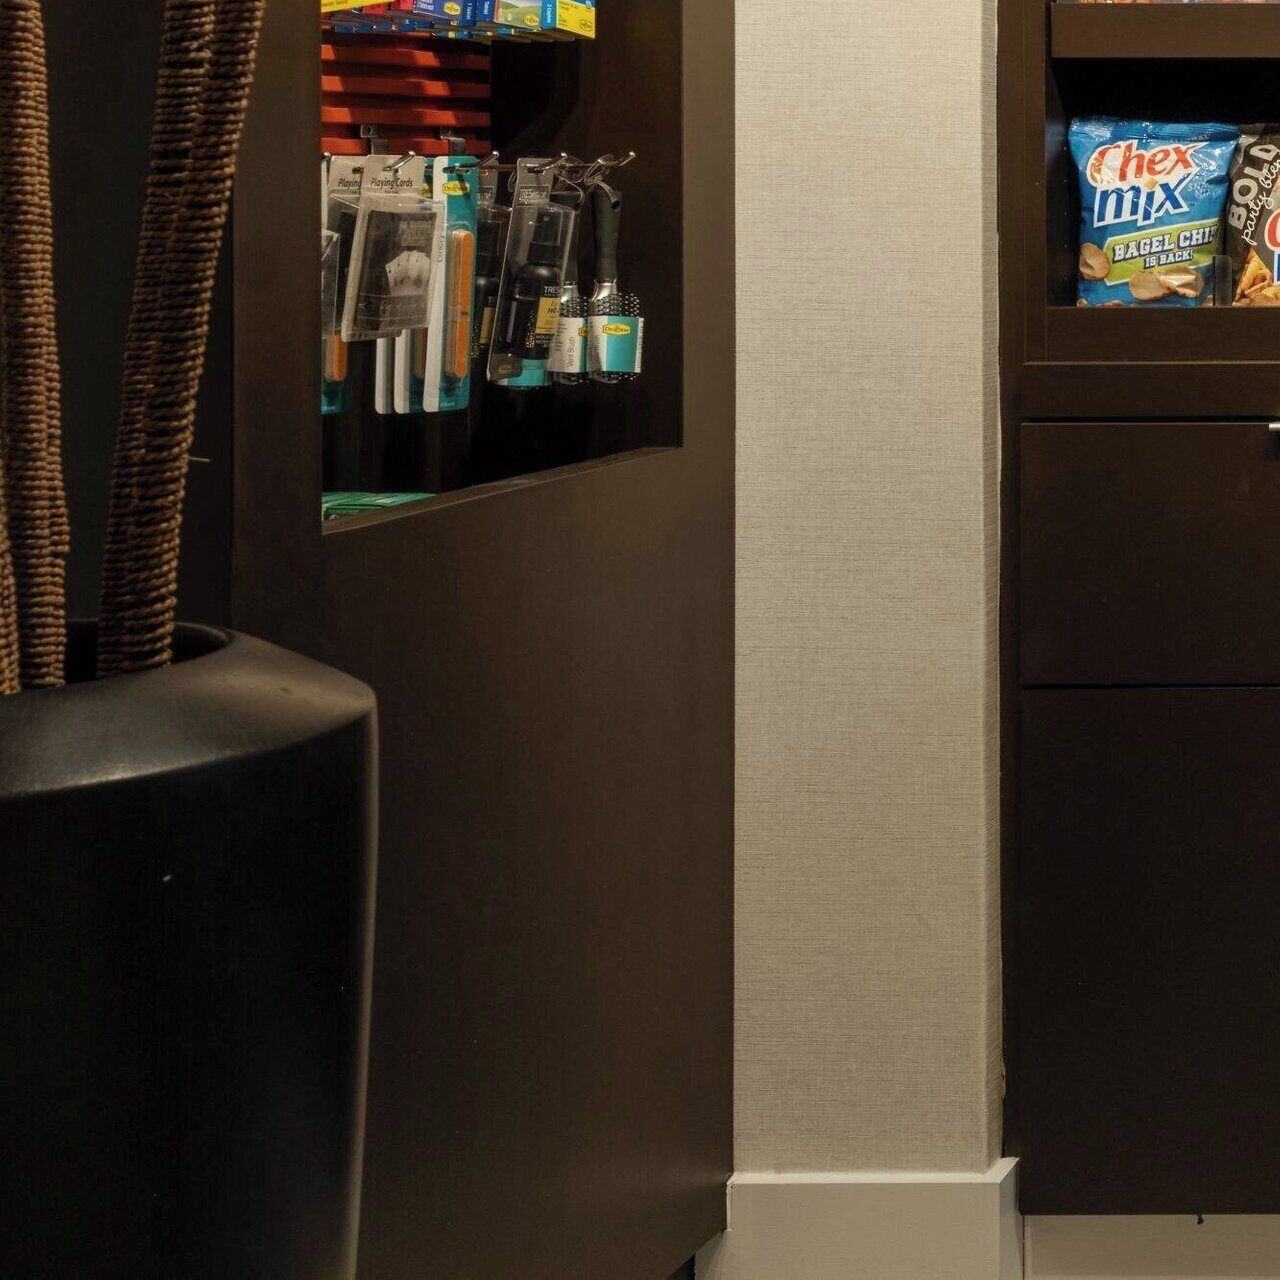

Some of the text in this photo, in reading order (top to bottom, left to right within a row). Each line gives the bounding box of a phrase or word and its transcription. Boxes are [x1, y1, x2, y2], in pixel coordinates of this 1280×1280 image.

[371, 177, 395, 190] Playing
[1088, 141, 1209, 186] Chex
[1095, 177, 1192, 225] mix
[1227, 143, 1280, 231] BOLD
[1241, 189, 1276, 246] party
[1113, 234, 1175, 263] BAGEL
[1144, 255, 1158, 269] IS
